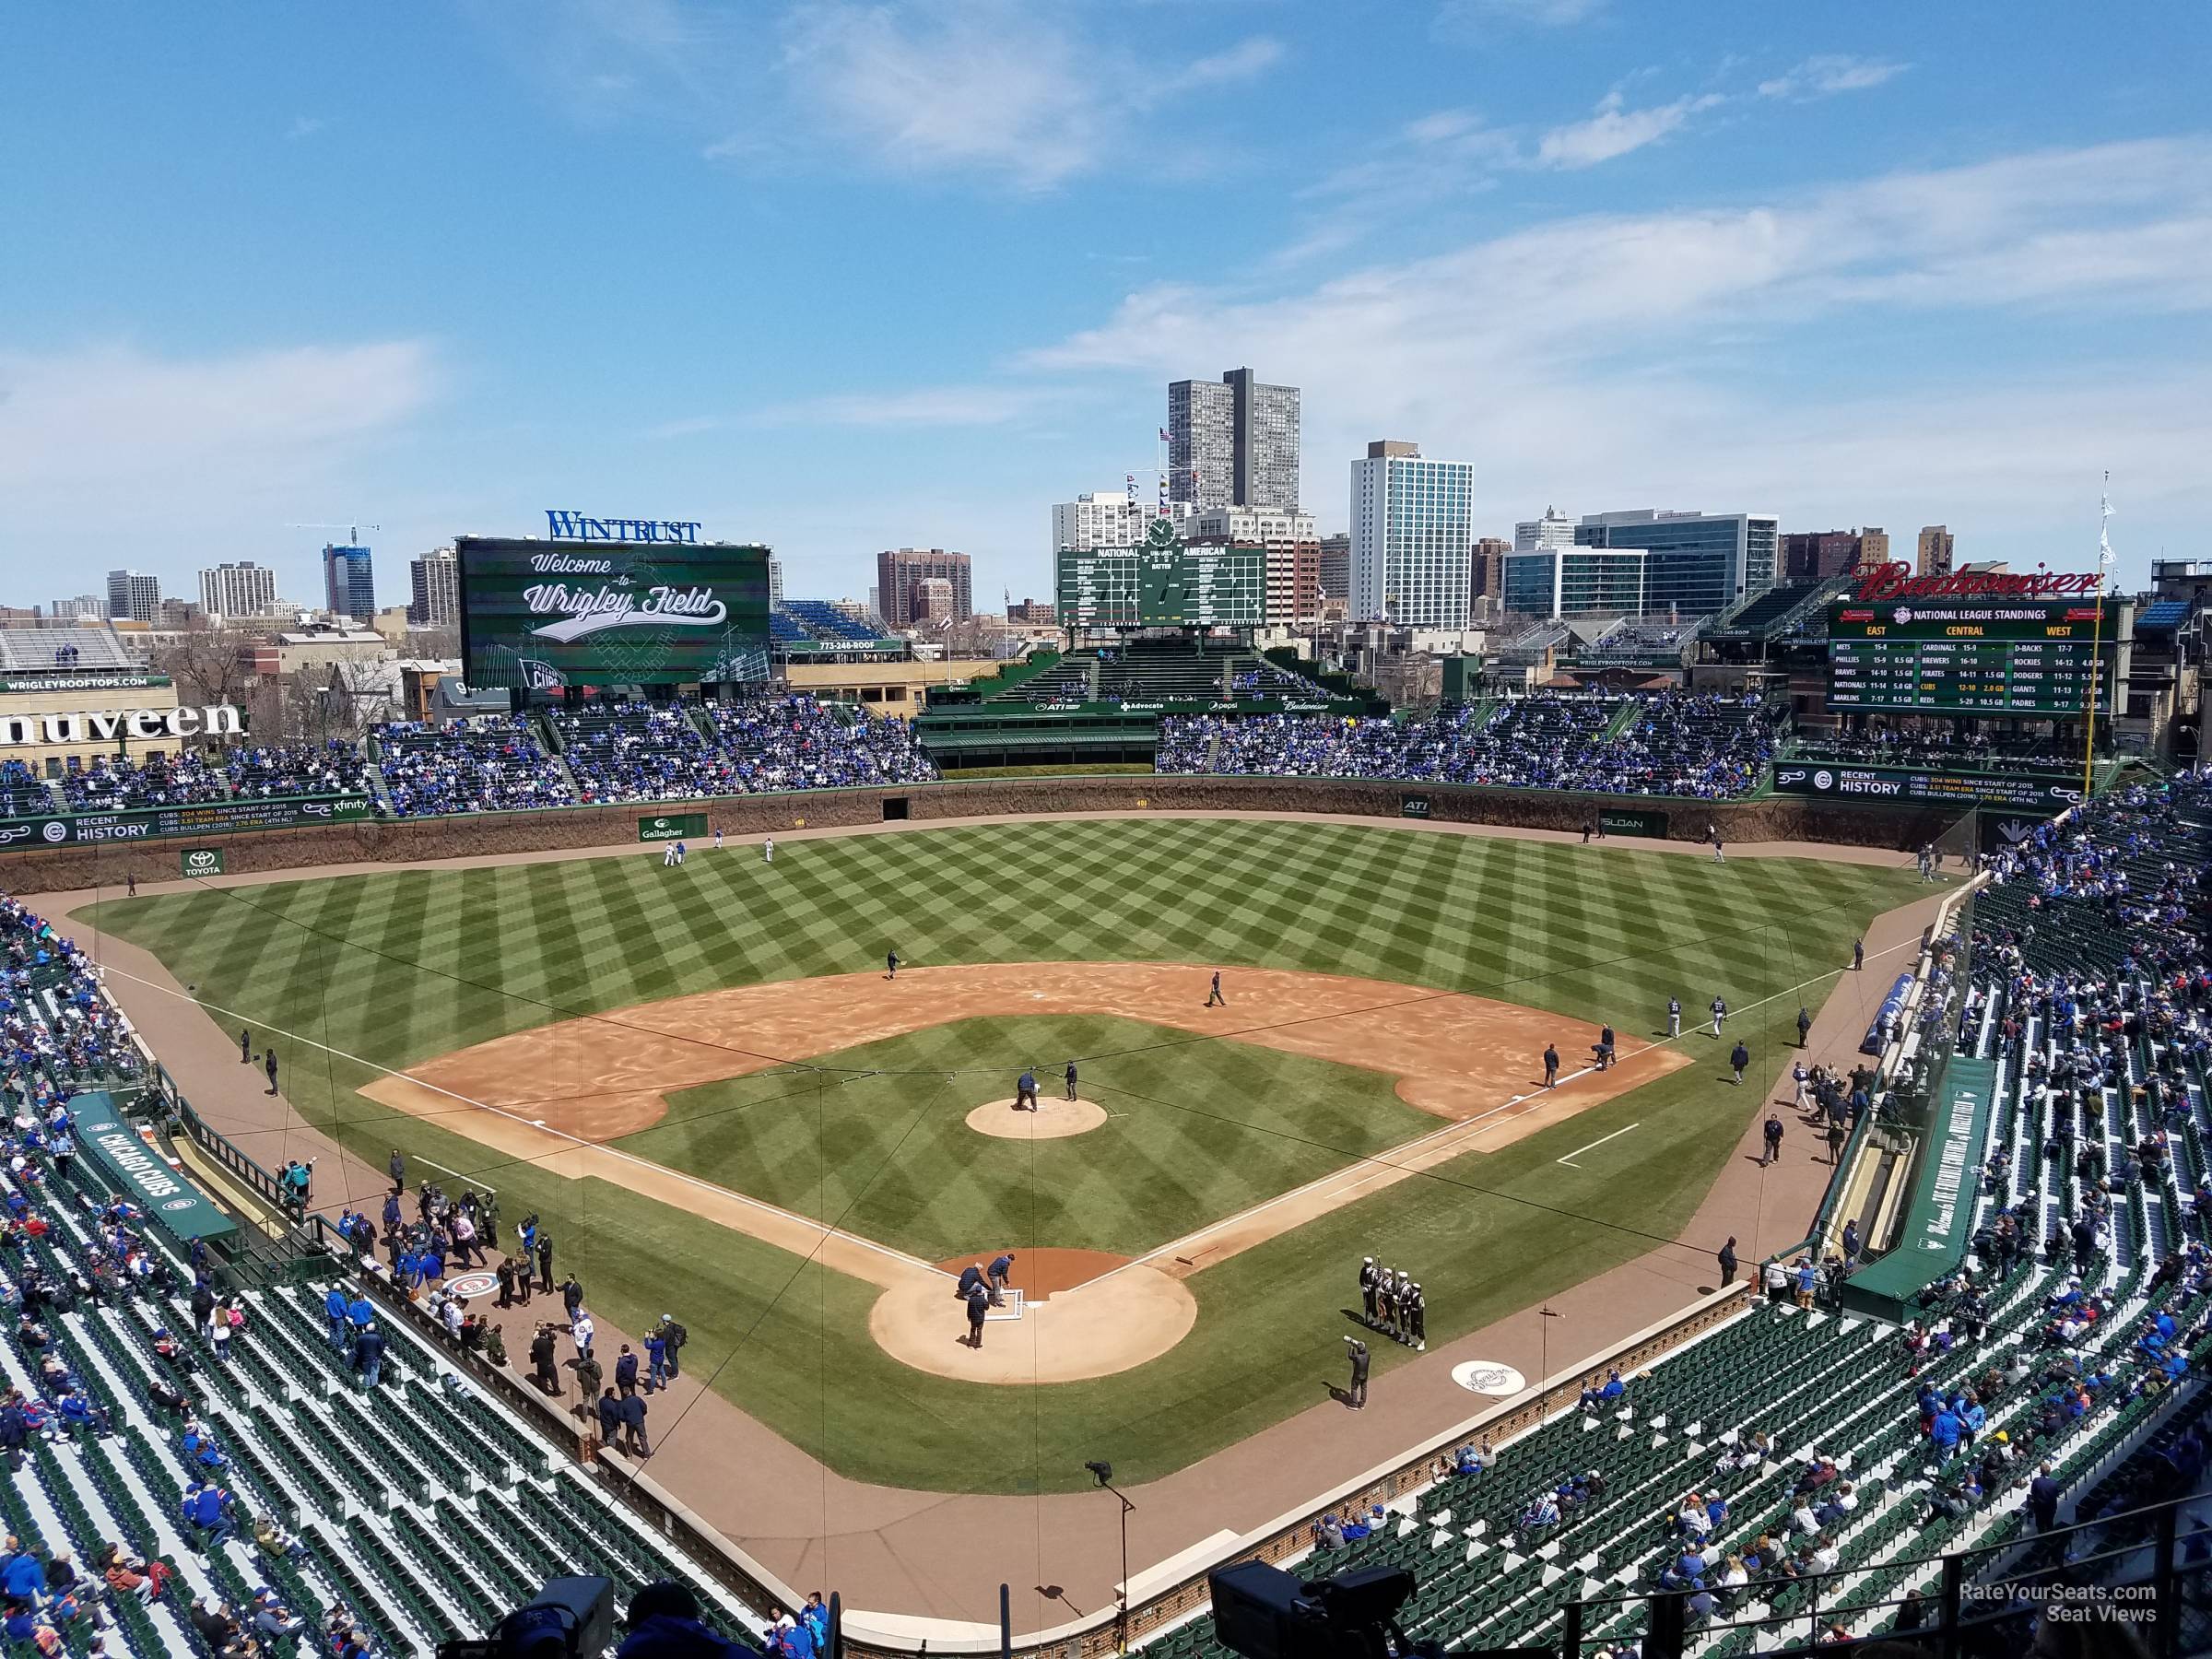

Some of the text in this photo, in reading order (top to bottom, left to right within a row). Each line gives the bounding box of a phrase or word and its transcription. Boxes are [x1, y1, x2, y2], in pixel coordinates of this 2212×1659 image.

[1098, 548, 1140, 557] NATIONAL
[1183, 547, 1226, 556] AMERICAN
[531, 554, 611, 573] Welcome
[1851, 561, 2105, 601] Budweiser
[524, 583, 712, 621] Wrigley Field
[1913, 609, 2046, 619] NATIONAL LEAGUE STANDINGS
[1866, 627, 1886, 636] EAST
[1947, 627, 1983, 636] CENTRAL
[2046, 627, 2072, 636] WEST
[819, 641, 876, 650] 773-248-ROOF
[7, 677, 147, 689] WRIGLEYROOFTOPS.COM
[1282, 701, 1330, 711] Budweiser
[0, 703, 243, 744] nuveen
[1841, 771, 1877, 780] RECENT
[1840, 781, 1901, 794] HISTORY
[334, 799, 368, 812] xfinity
[1404, 801, 1428, 810] ATI
[76, 816, 118, 827] RECENT
[1600, 818, 1643, 828] SLOAN
[76, 824, 149, 841] HISTORY
[642, 830, 684, 839] Gallagher
[185, 865, 220, 877] TOYOTA
[97, 1134, 181, 1197] CHICAGO CUBS
[1926, 1209, 1954, 1235] Welcome
